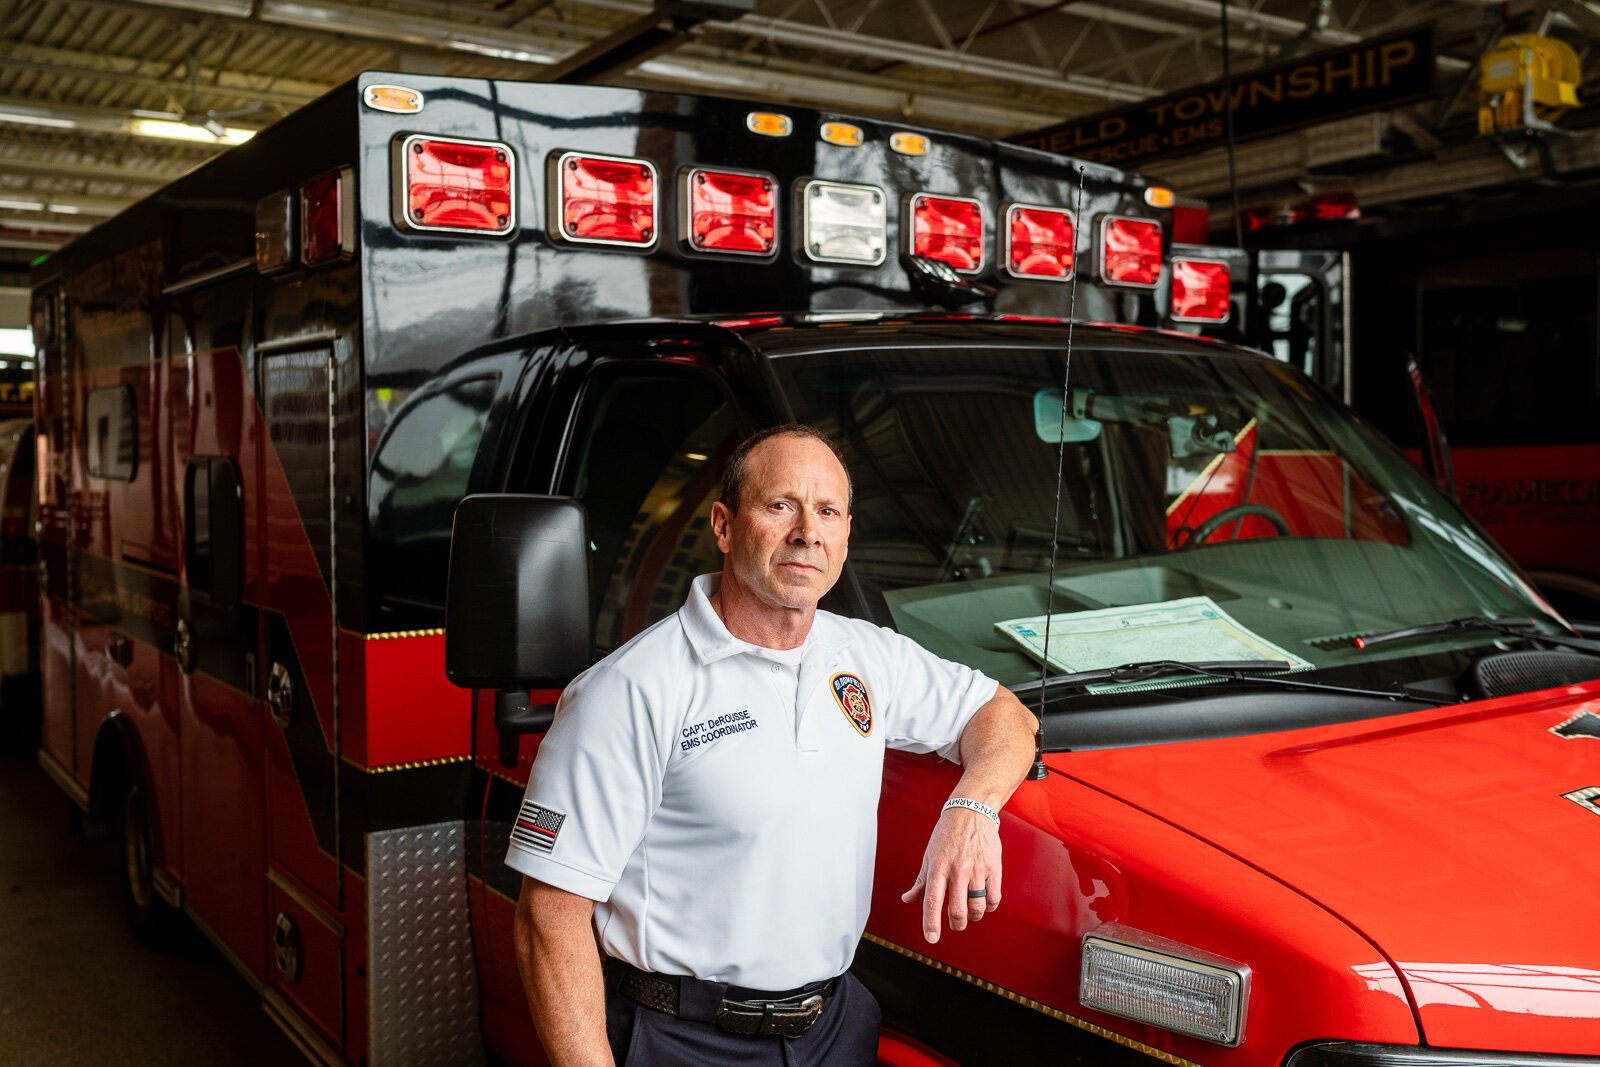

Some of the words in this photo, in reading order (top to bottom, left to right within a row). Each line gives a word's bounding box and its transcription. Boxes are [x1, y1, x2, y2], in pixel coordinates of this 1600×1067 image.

[1147, 38, 1418, 127] TOWNSHIP
[681, 737, 701, 751] EMS
[701, 719, 759, 744] COORDINATOR
[682, 722, 707, 737] CAPT.
[708, 710, 750, 729] DeROUSSE
[947, 798, 973, 807] ARMY
